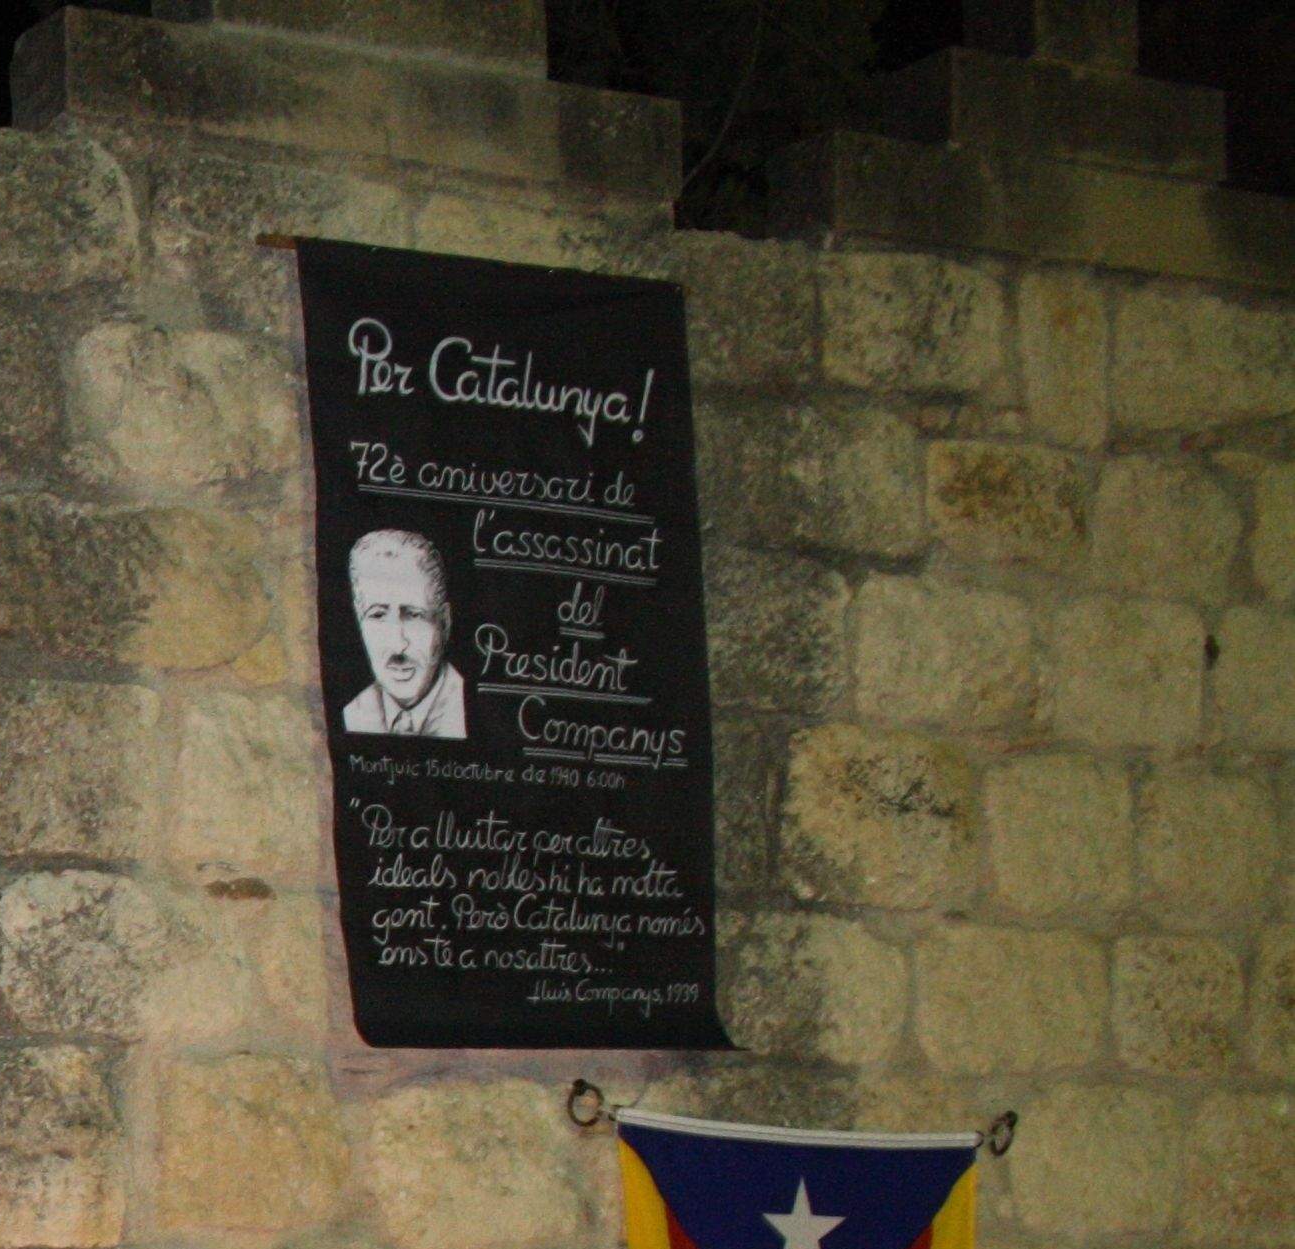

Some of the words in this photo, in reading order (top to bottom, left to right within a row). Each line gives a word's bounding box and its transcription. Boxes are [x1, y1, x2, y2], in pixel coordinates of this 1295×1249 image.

[348, 317, 414, 396] Per
[429, 336, 654, 447] Catalunya!
[350, 440, 406, 484] 72è
[418, 462, 594, 503] aniversari
[604, 471, 634, 506] de
[473, 509, 662, 573] l'assassinat
[558, 582, 604, 627] del
[475, 624, 638, 691] President
[518, 695, 686, 768] Companys
[425, 759, 440, 777] 15
[521, 764, 546, 784] de
[410, 826, 430, 849] a
[436, 810, 527, 851] lluitar
[533, 830, 573, 866] per
[367, 853, 457, 889] ideals
[468, 854, 545, 893] nobles
[549, 863, 571, 894] hi
[577, 861, 605, 896] ha
[612, 859, 684, 898] molta
[372, 895, 447, 945] gent.
[451, 893, 509, 930] Però
[513, 893, 632, 949] Catalunya
[638, 907, 706, 936] només
[378, 946, 428, 966] ens
[423, 934, 454, 967] té
[459, 948, 478, 968] a
[666, 983, 699, 1002] 1939
